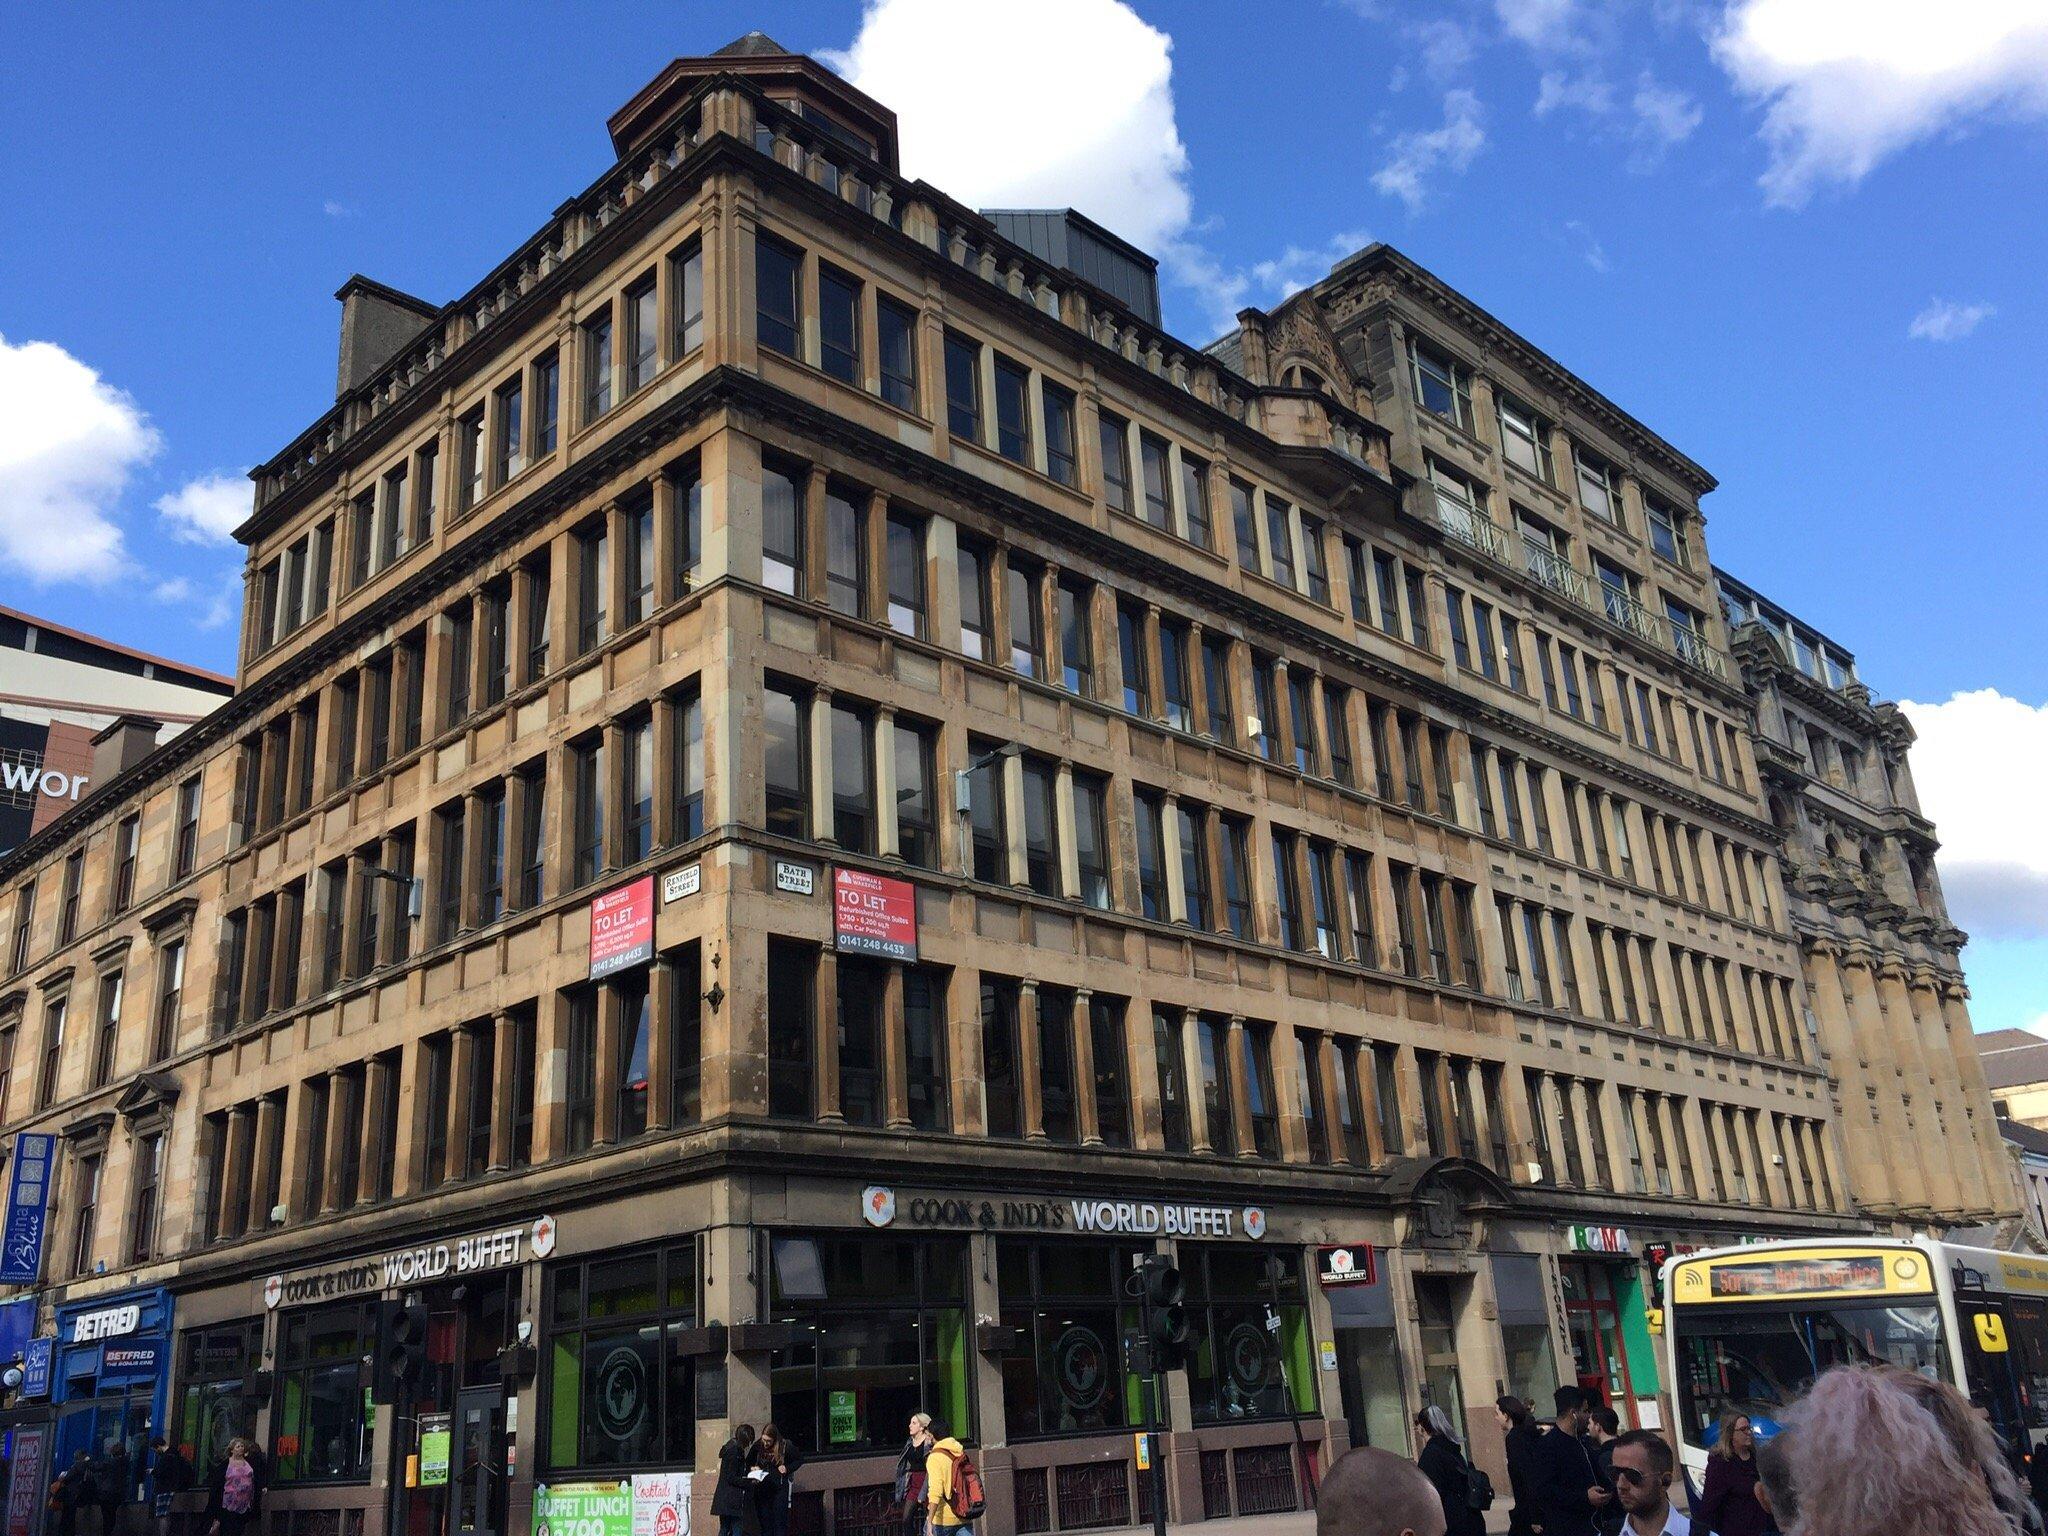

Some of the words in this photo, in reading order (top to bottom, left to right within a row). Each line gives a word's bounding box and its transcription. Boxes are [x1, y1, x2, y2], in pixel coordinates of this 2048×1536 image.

[666, 868, 698, 888] RENFIELD
[778, 873, 811, 888] STREET
[783, 865, 807, 878] BATH
[669, 880, 695, 895] STREET
[853, 880, 882, 891] WAKEFIELD
[839, 889, 860, 905] TO
[864, 894, 887, 911] LET
[595, 915, 611, 932] TO
[614, 906, 633, 925] LET
[839, 905, 874, 918] Refurbished
[875, 912, 891, 921] Office
[839, 923, 853, 931] with
[854, 924, 865, 932] Car
[866, 926, 887, 938] Parking
[839, 934, 861, 947] 0141
[863, 938, 881, 950] 248
[882, 942, 905, 955] 4433
[592, 960, 609, 974] 0141
[609, 954, 624, 968] 248
[910, 1198, 975, 1226] COOK
[978, 1201, 997, 1226] &
[1071, 1200, 1160, 1233] WORLD
[1164, 1205, 1233, 1236] BUFFET
[13, 1213, 39, 1270] Blue
[1567, 1226, 1632, 1252] ROMA
[286, 1274, 321, 1302] COOK
[382, 1245, 451, 1286] WORLD
[457, 1229, 524, 1272] BUFFET
[1321, 1273, 1343, 1281] WORLD
[1344, 1272, 1365, 1280] BUFFET
[73, 1305, 140, 1343] BETFRED
[106, 1350, 155, 1360] BETFRED
[635, 1480, 670, 1499] Cocktails
[537, 1498, 580, 1517] BUFFET
[584, 1497, 629, 1516] LUNCH
[661, 1511, 670, 1521] ALL
